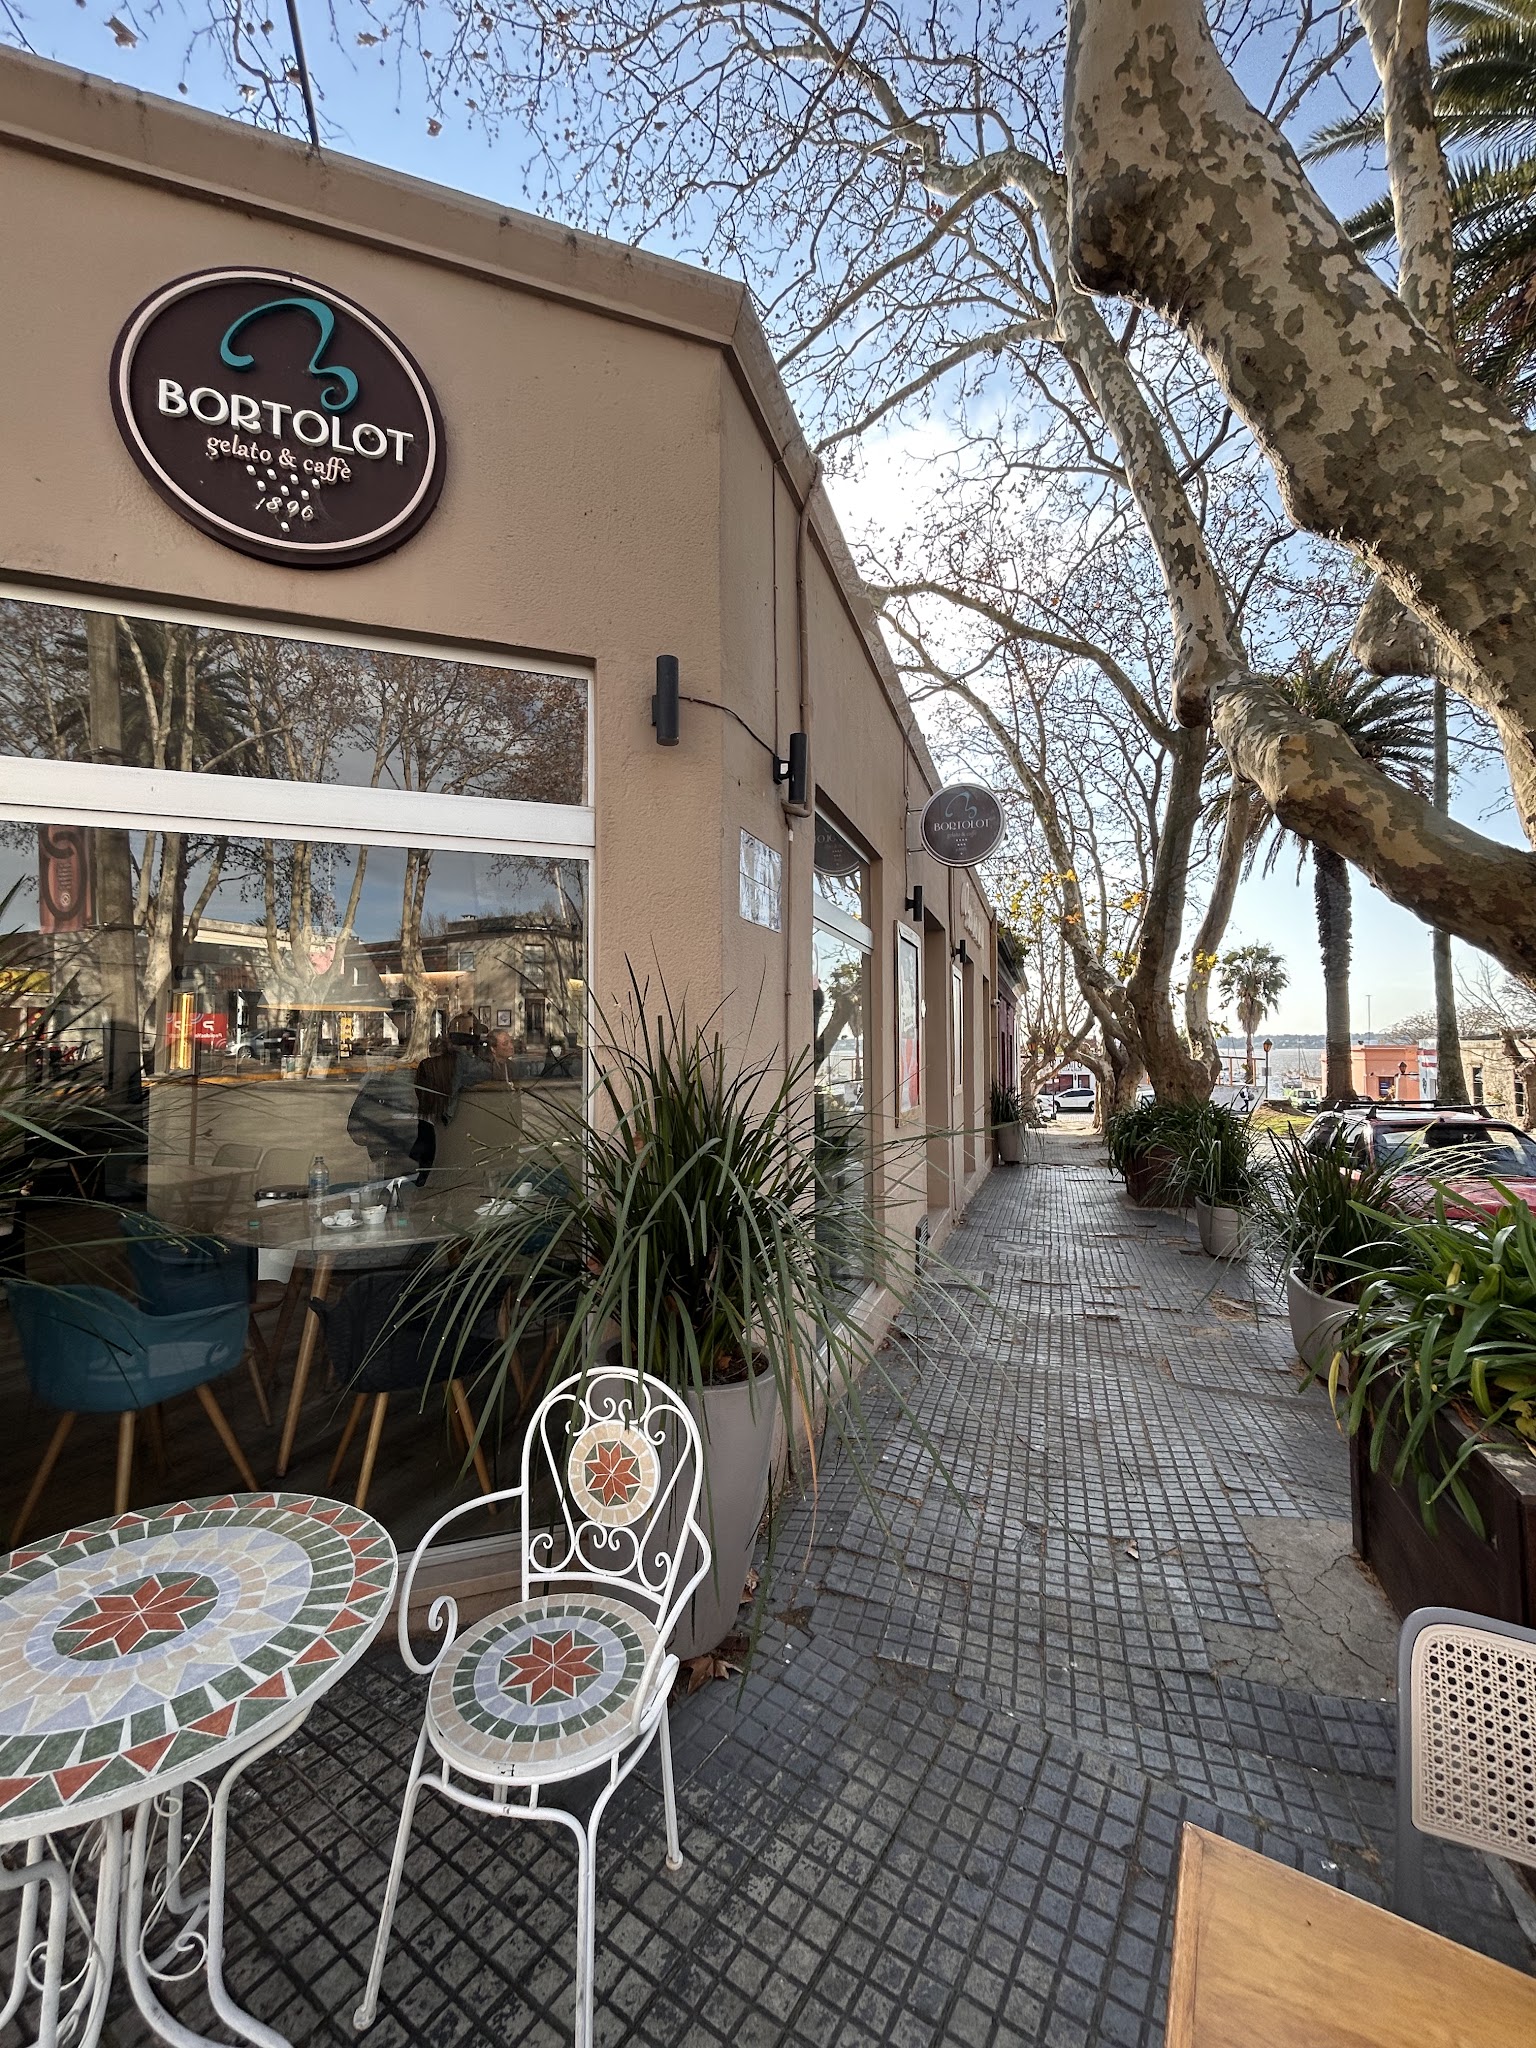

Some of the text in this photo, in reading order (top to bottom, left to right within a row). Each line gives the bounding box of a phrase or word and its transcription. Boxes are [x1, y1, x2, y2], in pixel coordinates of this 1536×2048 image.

[158, 378, 414, 465] BORTOLOT
[206, 434, 352, 483] gelato & caffè
[255, 496, 315, 521] 1896
[934, 819, 990, 831] BORTOLOT
